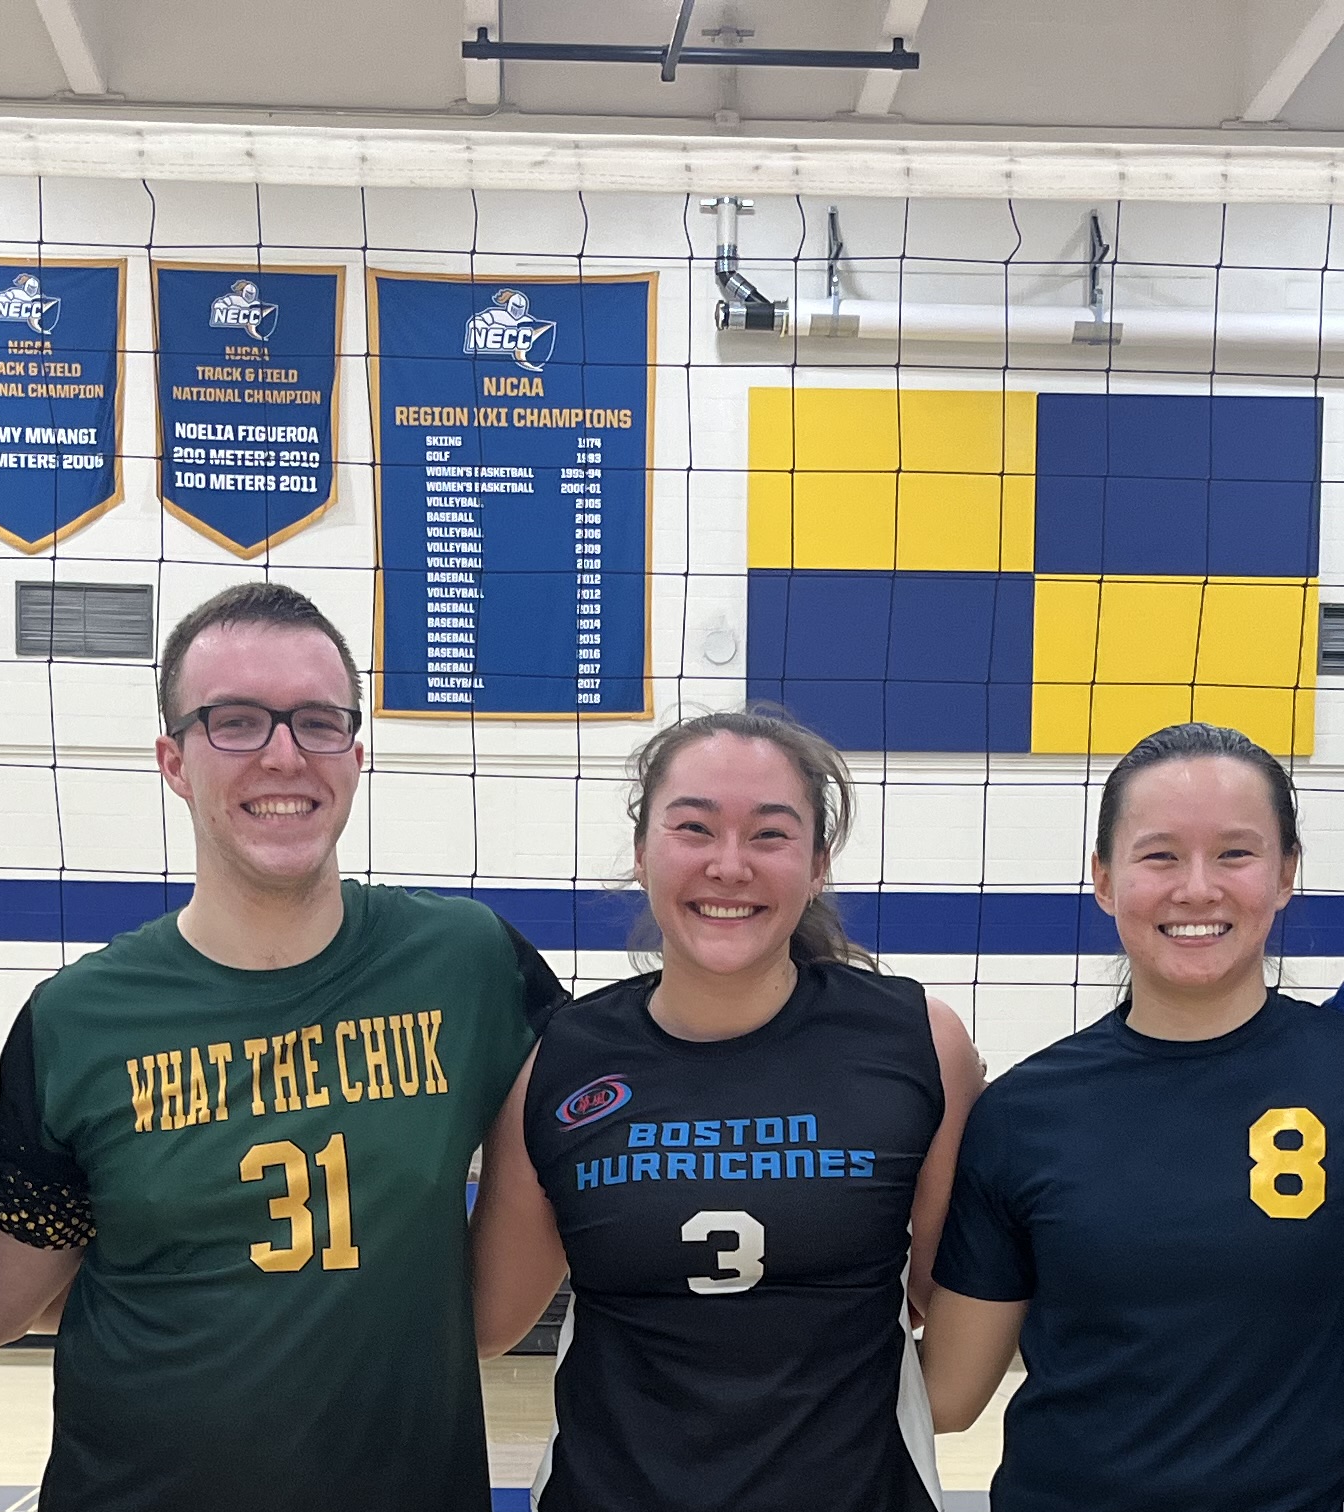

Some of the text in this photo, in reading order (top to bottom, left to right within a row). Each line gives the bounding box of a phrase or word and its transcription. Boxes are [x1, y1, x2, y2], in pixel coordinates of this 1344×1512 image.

[214, 307, 261, 325] NECC
[470, 327, 533, 350] NECC
[8, 340, 52, 355] NJCAA
[42, 362, 82, 377] FIELD
[196, 366, 242, 381] TRACK
[258, 368, 298, 383] FIELD
[28, 382, 104, 399] CHAMPION
[173, 385, 321, 405] NATIONAL CHAMPION
[483, 377, 544, 397] NJCAA
[395, 406, 632, 429] REGION XXI CHAMPIONS
[25, 427, 97, 444] MWANGI
[175, 422, 319, 443] NOELIA FIGUEROA
[425, 436, 462, 448] SKIING
[173, 446, 320, 468] 200 METERS 2010
[425, 451, 450, 462] GOLF
[426, 466, 473, 478] WOMEN'S
[475, 467, 535, 479] BASKETBALL
[175, 471, 318, 493] 100 METERS 2011
[426, 481, 473, 493] WOMEN'S
[426, 511, 474, 523] BASEBALL
[427, 572, 475, 583] BASEBALL
[427, 602, 475, 613] BASEBALL
[427, 617, 475, 628] BASEBALL
[427, 632, 475, 643] BASEBALL
[427, 647, 475, 659] BASEBALL
[578, 663, 601, 674] 2017
[577, 678, 601, 689] 2017
[126, 1009, 449, 1133] WHAT THE CHUK
[627, 1113, 818, 1148] BOSTON
[574, 1149, 876, 1191] HURRICANES
[1248, 1106, 1327, 1219] 8
[239, 1132, 360, 1273] 31
[681, 1210, 766, 1295] 3
